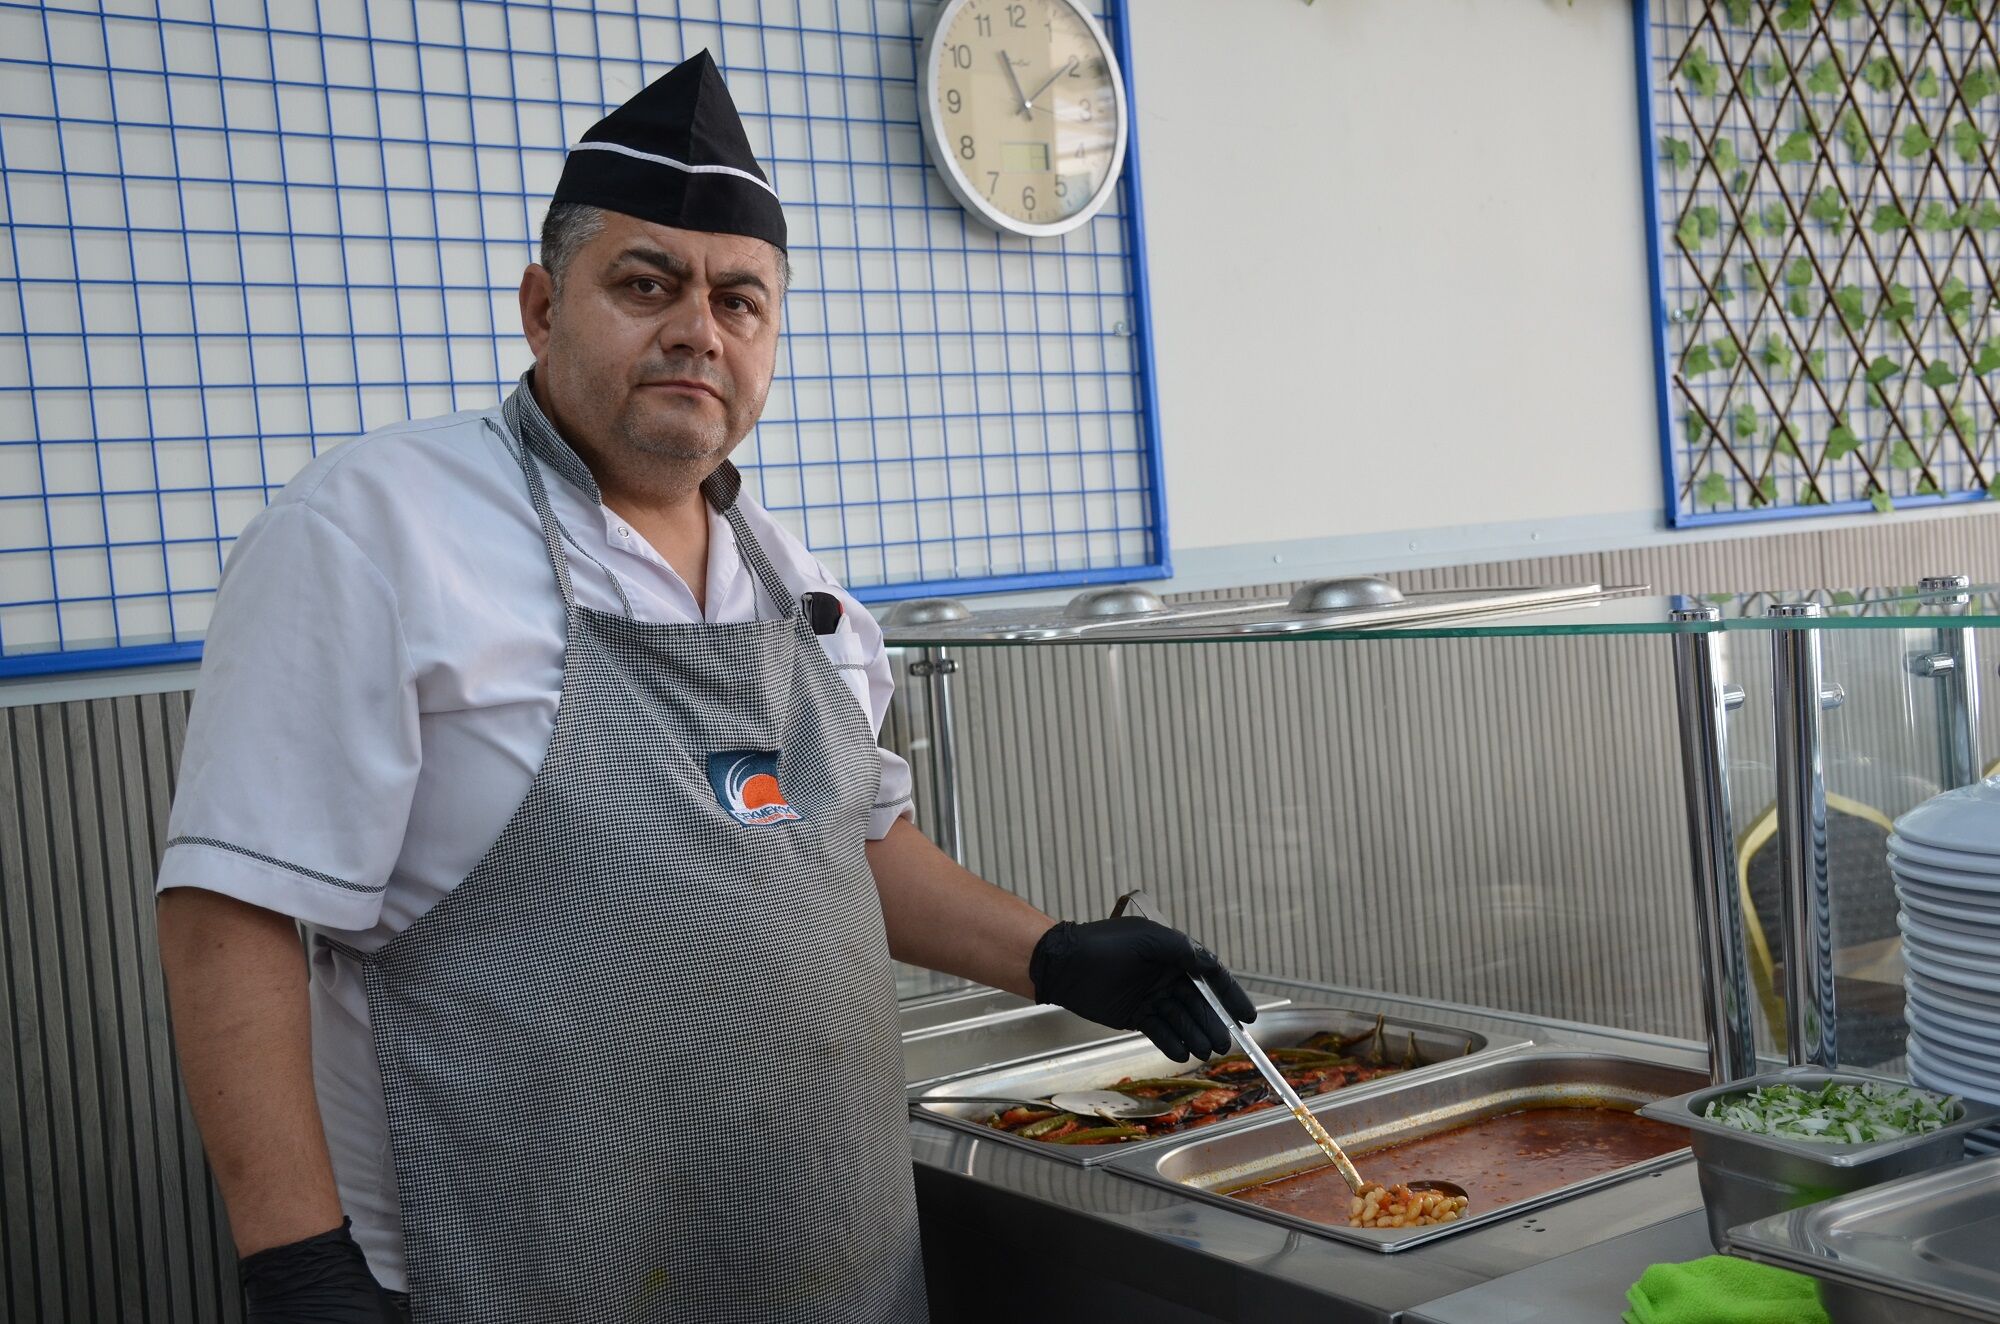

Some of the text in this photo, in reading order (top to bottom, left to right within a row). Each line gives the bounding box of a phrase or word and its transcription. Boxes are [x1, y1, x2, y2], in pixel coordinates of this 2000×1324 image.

[974, 13, 992, 37] 11
[1005, 5, 1026, 28] 12
[1044, 22, 1053, 43] 1
[950, 44, 972, 70] 10
[1068, 55, 1081, 78] 2
[947, 89, 962, 114] 9
[1079, 98, 1093, 122] 3
[960, 135, 975, 160] 8
[1075, 143, 1086, 159] 4
[986, 171, 999, 195] 7
[1054, 175, 1067, 198] 5
[1022, 186, 1036, 211] 6
